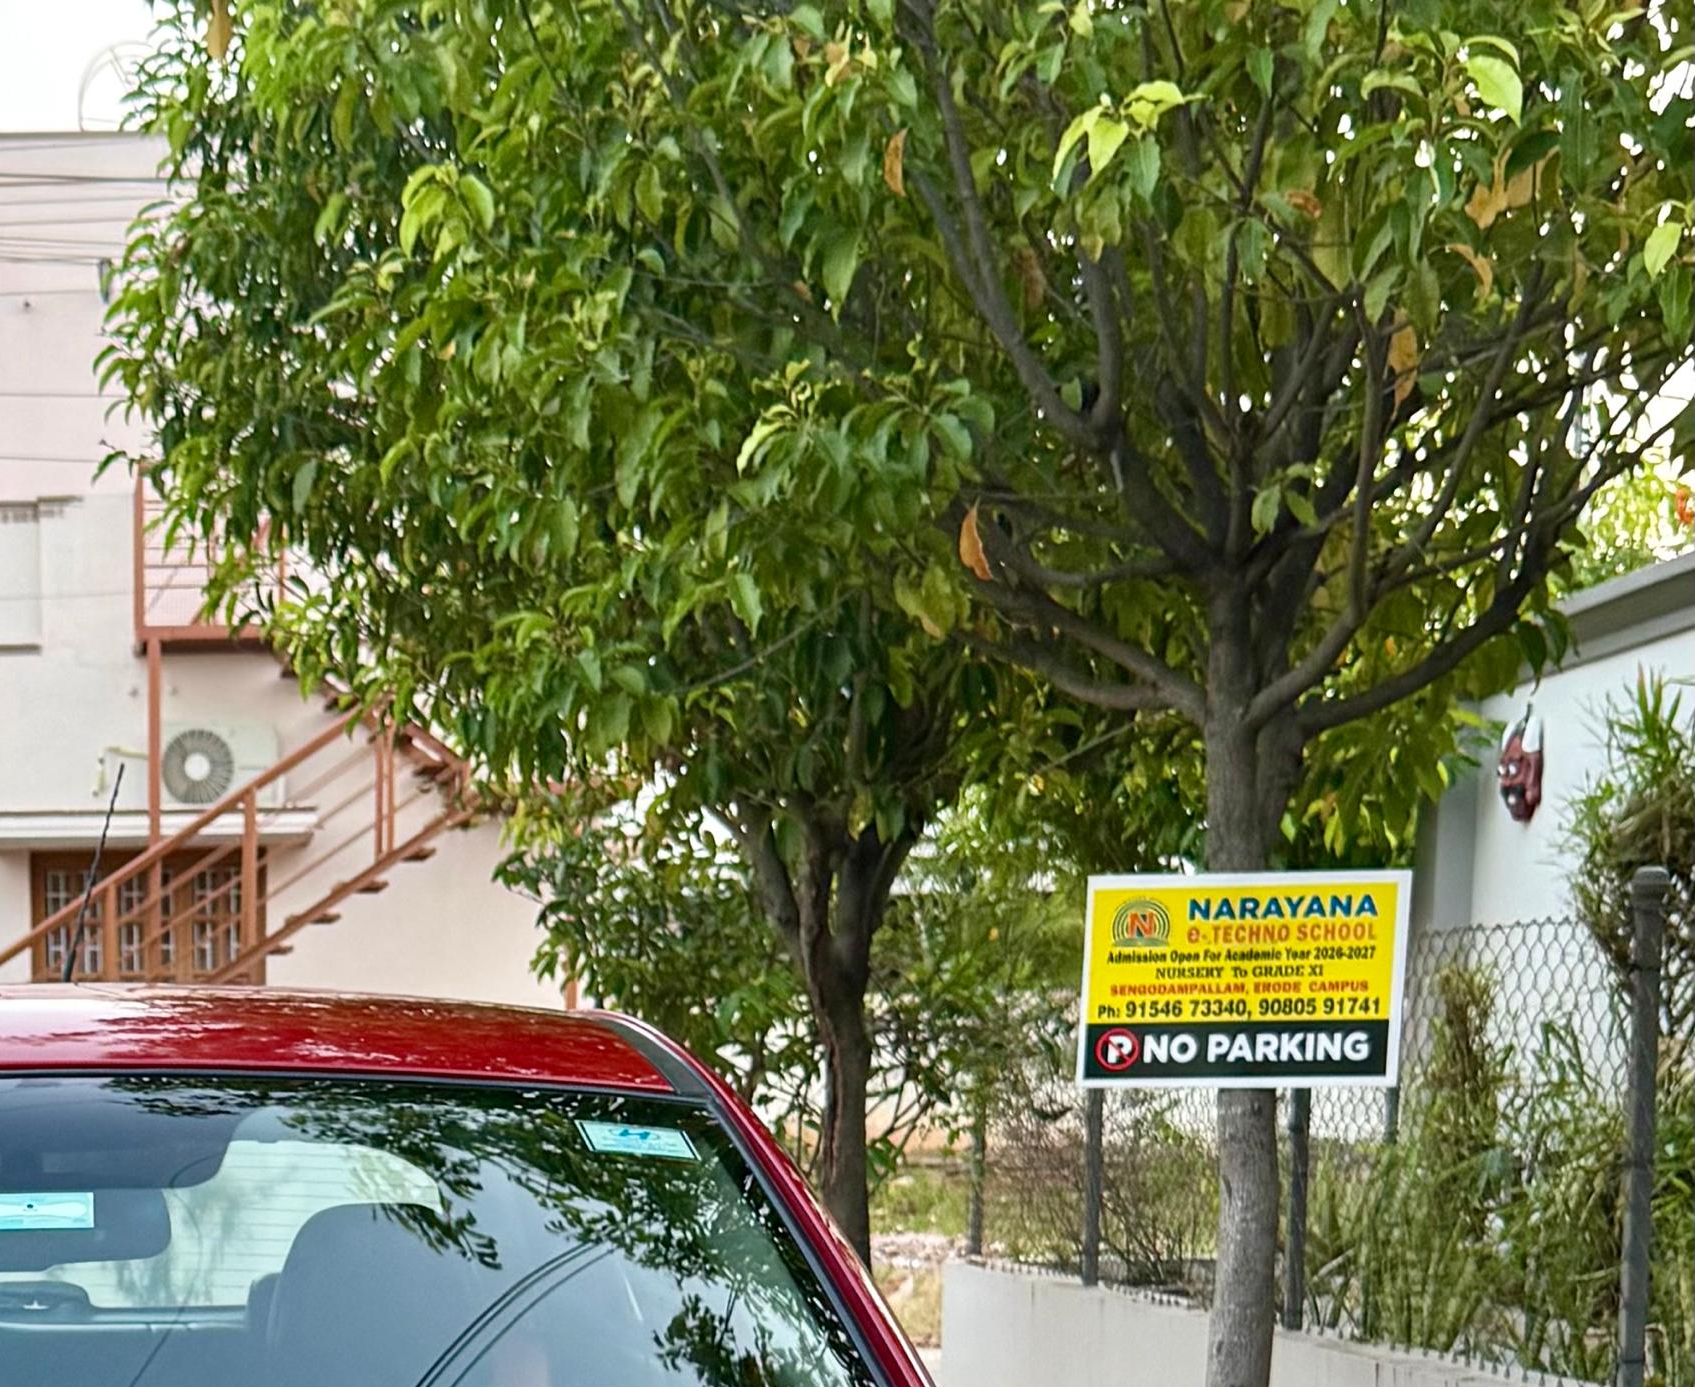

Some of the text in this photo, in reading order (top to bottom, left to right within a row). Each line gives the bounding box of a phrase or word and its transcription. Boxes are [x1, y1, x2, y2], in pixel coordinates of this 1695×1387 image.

[1188, 893, 1378, 921] NARAYANA
[1296, 922, 1377, 942] SCHOOL
[1107, 945, 1376, 965] Admission Open For Academic Year 2026-2027
[1155, 966, 1224, 980] NURSERY
[1252, 965, 1304, 978] GRADE
[1308, 964, 1324, 977] XI
[1253, 981, 1302, 994] ERODE
[1308, 980, 1369, 993] CAMPUS
[1098, 997, 1381, 1020] Ph: 91546 73340, 90805 91741
[1143, 1033, 1198, 1064] NO
[1207, 1031, 1371, 1063] PARKING
